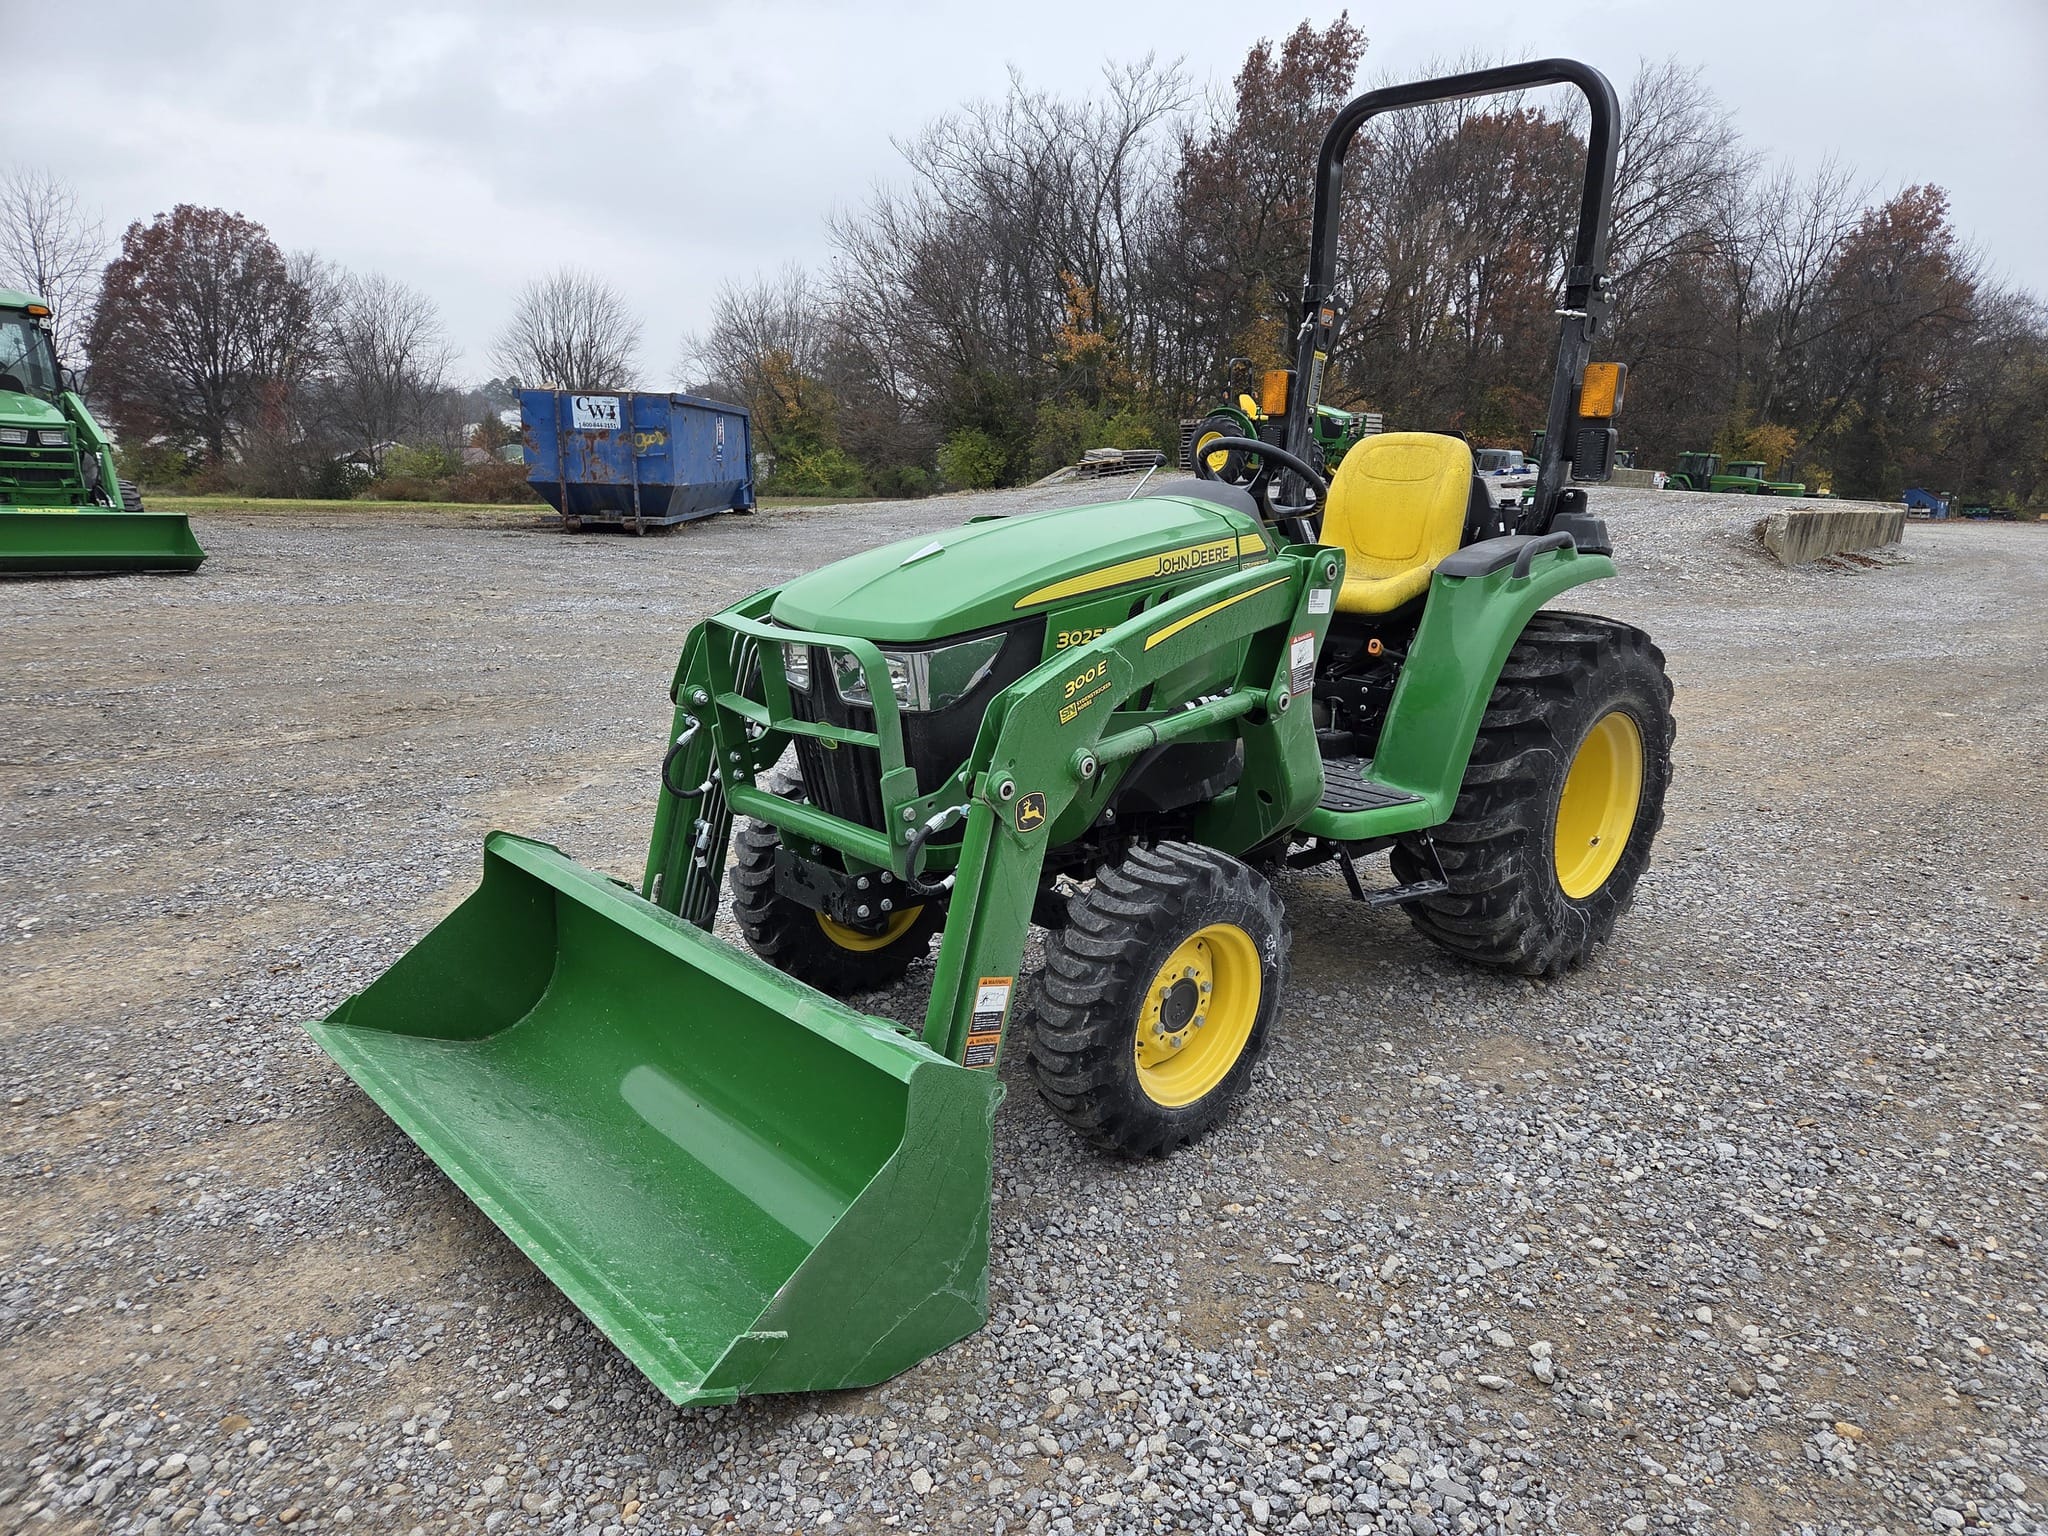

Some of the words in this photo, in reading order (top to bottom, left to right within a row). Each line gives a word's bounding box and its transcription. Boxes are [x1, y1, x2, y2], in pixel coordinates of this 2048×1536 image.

[1154, 555, 1190, 576] JOHN
[1191, 546, 1229, 566] DEERE
[1056, 627, 1114, 649] 3025
[1064, 668, 1096, 699] 300
[1096, 659, 1108, 677] E
[1061, 705, 1076, 719] SN
